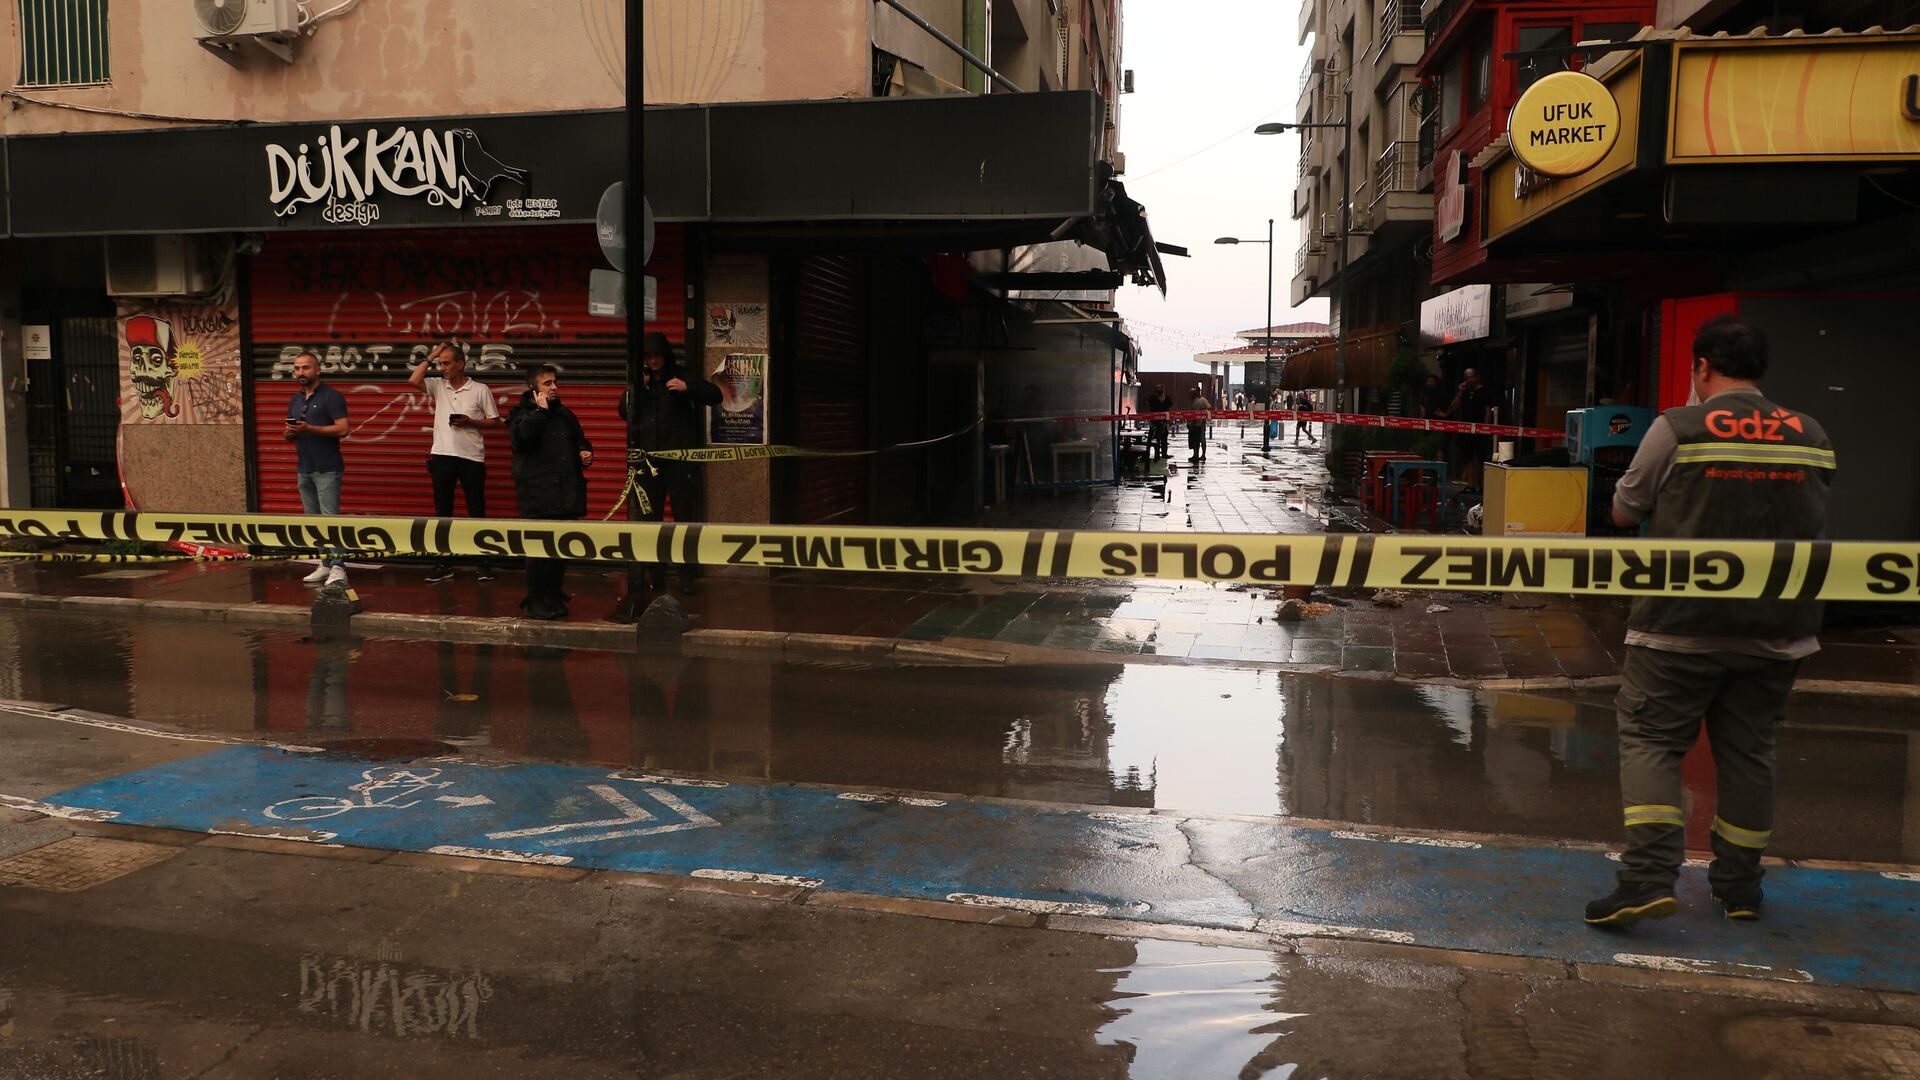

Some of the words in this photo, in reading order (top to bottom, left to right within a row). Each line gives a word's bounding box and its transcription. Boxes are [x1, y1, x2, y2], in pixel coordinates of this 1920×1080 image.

[1543, 102, 1593, 122] UFUK
[1530, 124, 1606, 146] MARKET
[265, 125, 464, 211] DÜKKAN
[322, 197, 379, 226] design
[1705, 409, 1784, 441] Gdz
[1705, 467, 1743, 480] Hayat
[1866, 552, 1920, 595] S
